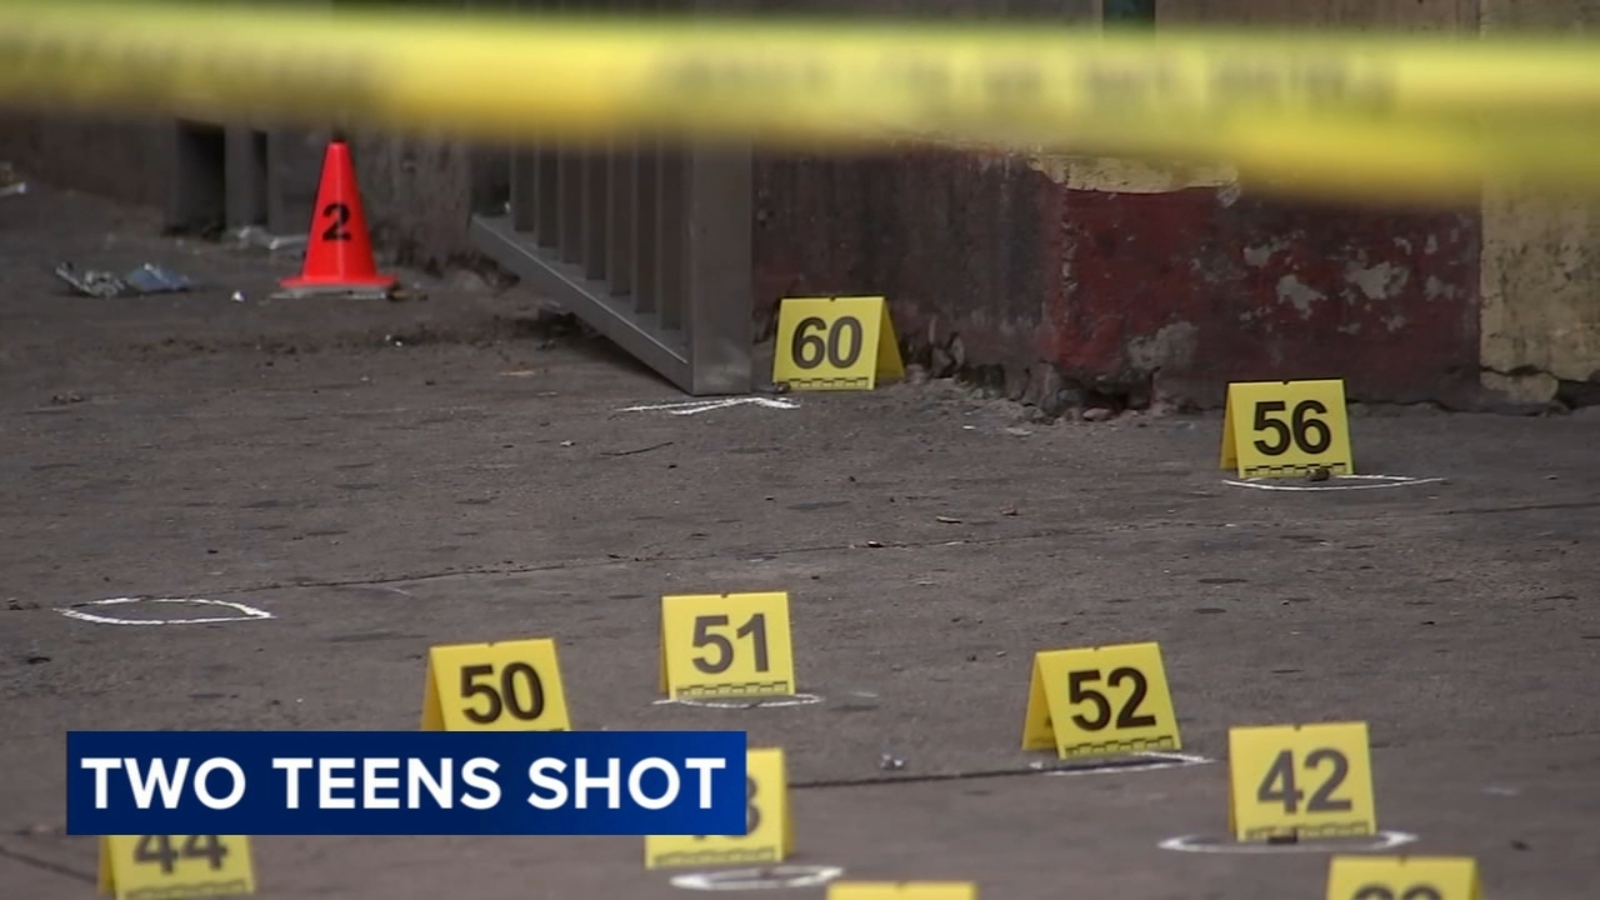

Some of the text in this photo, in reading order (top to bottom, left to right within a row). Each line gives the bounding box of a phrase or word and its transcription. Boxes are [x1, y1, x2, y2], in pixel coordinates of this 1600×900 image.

[321, 202, 352, 241] 2
[790, 315, 862, 369] 60
[1252, 399, 1332, 456] 56
[691, 612, 770, 676] 51
[459, 661, 546, 725] 50
[1067, 666, 1157, 732] 52
[1256, 748, 1352, 815] 42
[133, 835, 228, 874] 44
